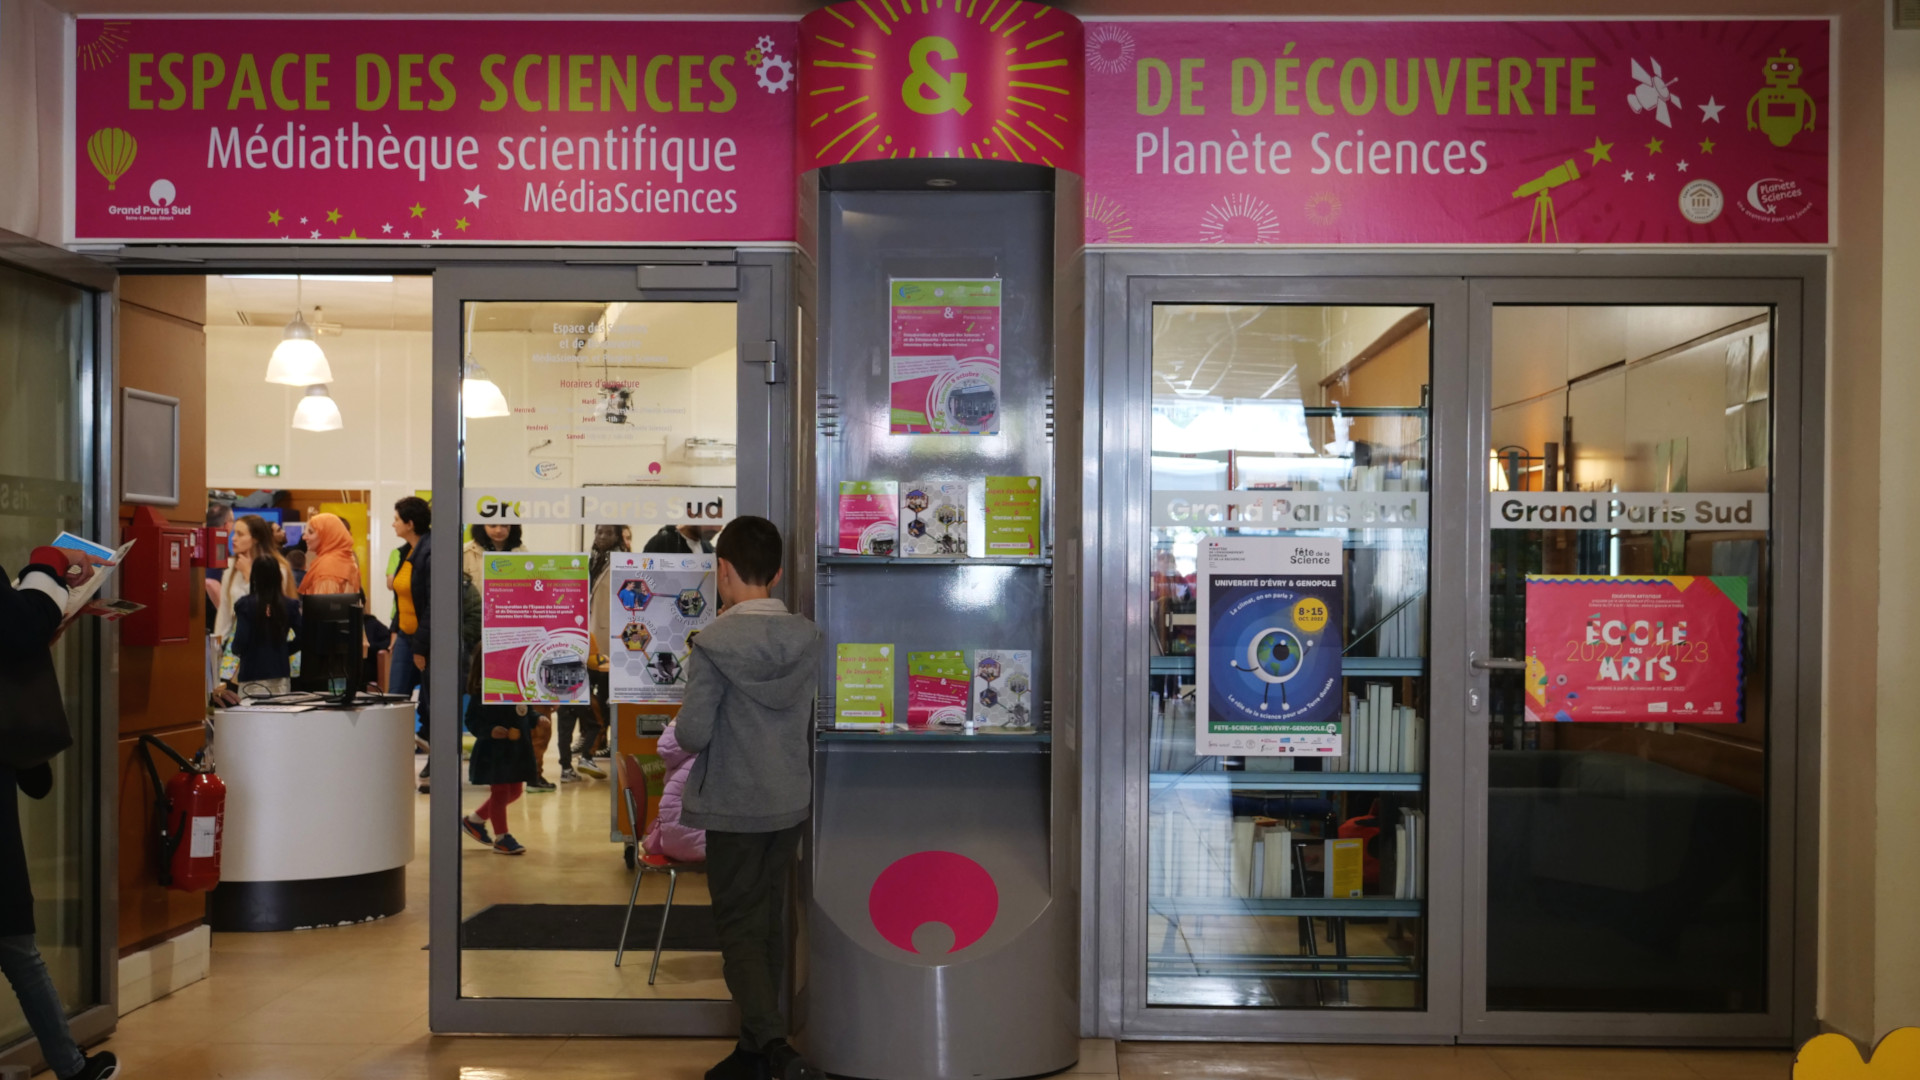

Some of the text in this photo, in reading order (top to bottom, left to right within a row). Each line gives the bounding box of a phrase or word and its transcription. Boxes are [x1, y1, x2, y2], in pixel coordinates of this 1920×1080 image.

[129, 53, 738, 113] ESPACE DES SCIENCES
[902, 36, 973, 116] &
[1136, 41, 1596, 116] DE DÉCOUVERTE
[207, 121, 738, 183] Médiathèque scientifique
[1136, 129, 1488, 175] Planète Sciences
[523, 178, 738, 213] MédiaSciences
[1761, 188, 1802, 203] Sciences
[108, 205, 191, 215] Grand Paris Sud
[553, 323, 585, 335] Espace
[572, 338, 586, 349] de
[560, 379, 592, 388] Horaires
[476, 495, 723, 518] Grand Paris Sud
[1167, 498, 1417, 522] Grand Paris Sud
[1502, 500, 1752, 524] Grand Paris Sud
[1290, 556, 1330, 564] Science
[1294, 548, 1314, 556] fête
[534, 580, 544, 591] &
[634, 572, 656, 589] CLUBS
[1215, 578, 1258, 586] UNIVERSITÉ
[1260, 578, 1287, 586] D'ÉVRY
[1586, 612, 1687, 646] ÉCOLE
[1596, 656, 1677, 681] ARTS
[1307, 697, 1321, 709] Terre
[1319, 678, 1334, 698] durable
